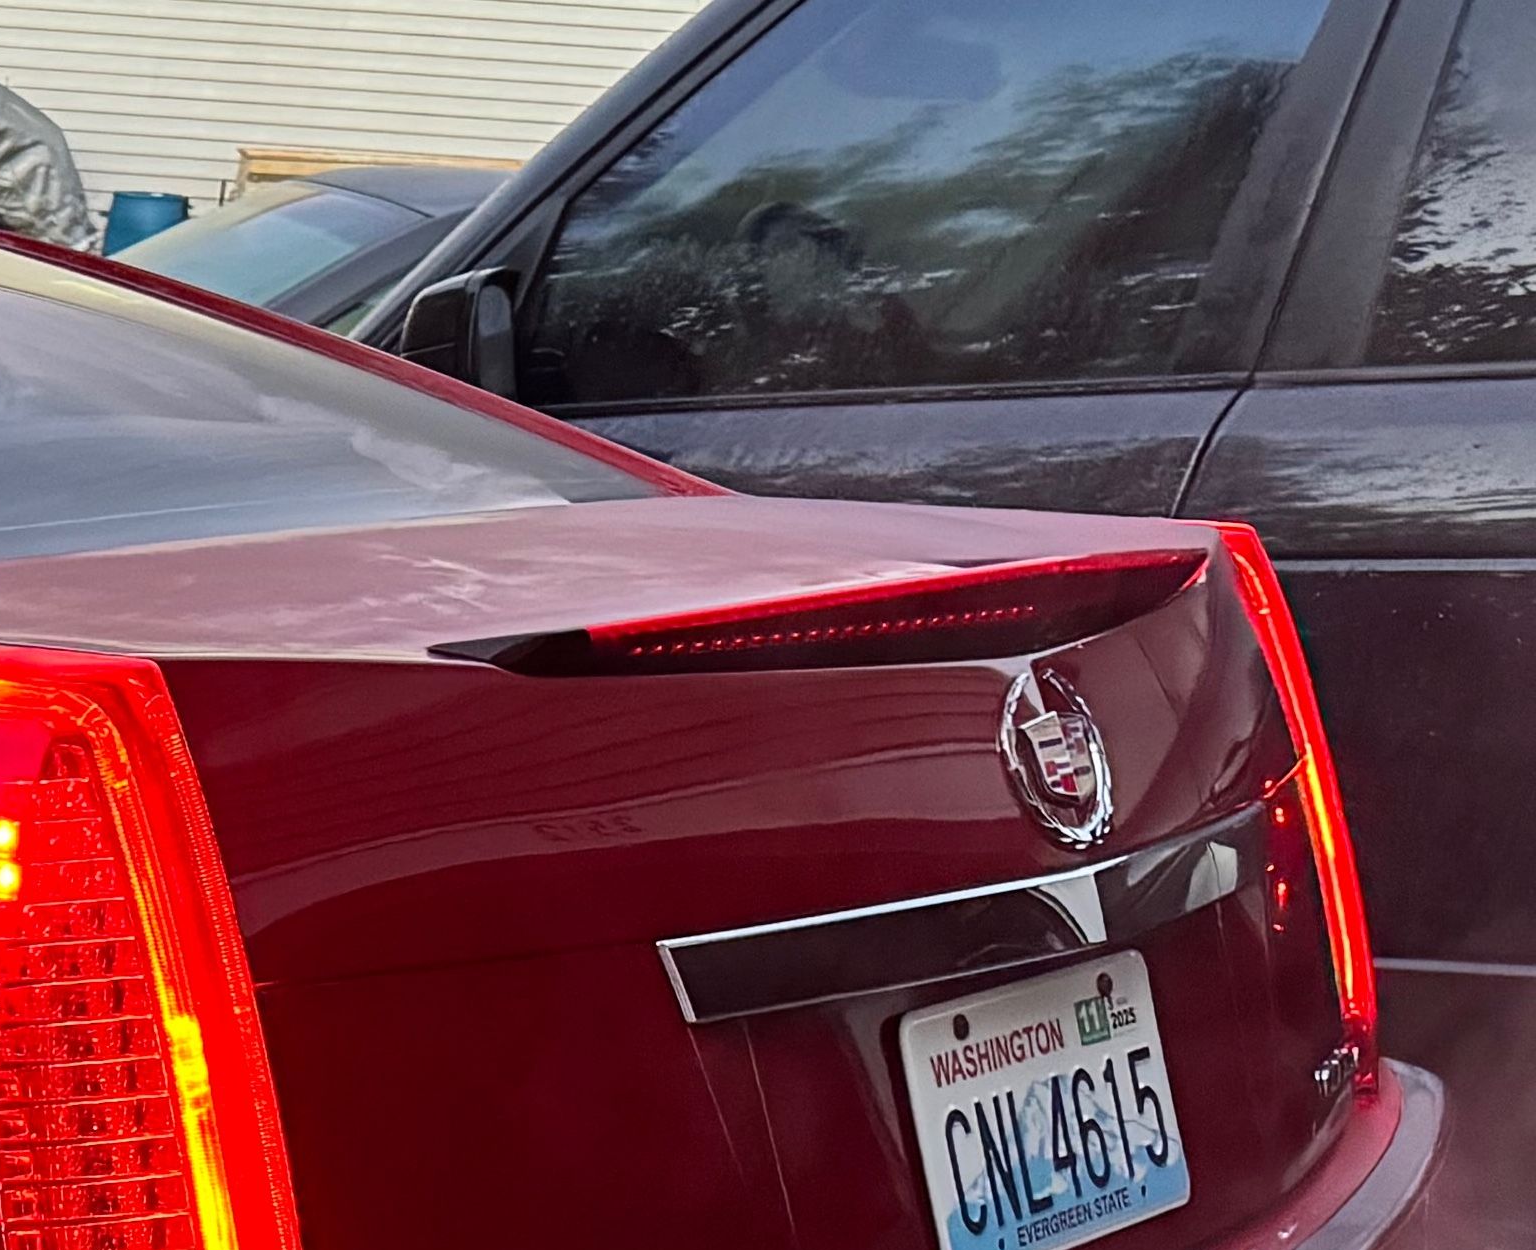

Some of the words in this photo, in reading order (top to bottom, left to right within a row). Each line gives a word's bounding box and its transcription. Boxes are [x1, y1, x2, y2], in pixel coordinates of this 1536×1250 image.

[1078, 1000, 1101, 1034] 11
[1110, 1006, 1137, 1030] 2025
[930, 1018, 1065, 1088] WASHINGTON
[944, 1046, 1169, 1236] CNL4615
[1017, 1201, 1093, 1247] EVERGREEN
[1093, 1186, 1132, 1219] STATE
